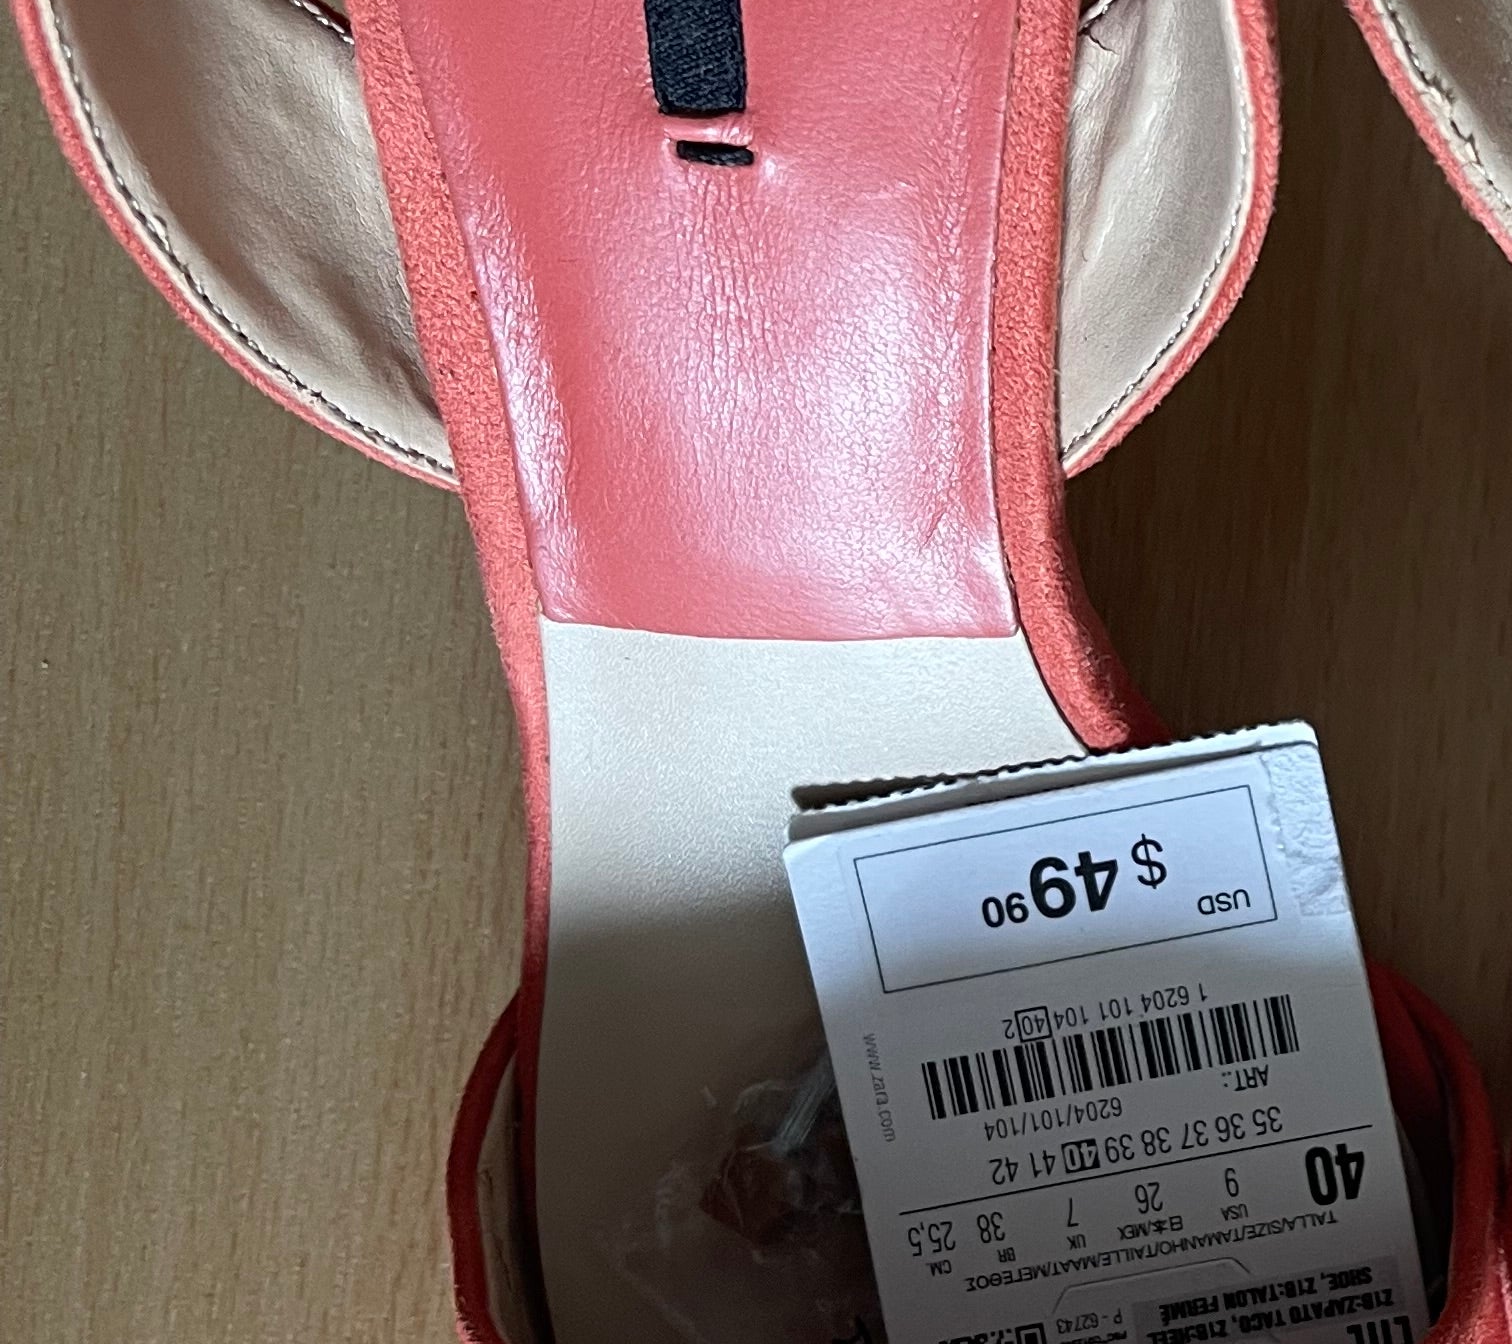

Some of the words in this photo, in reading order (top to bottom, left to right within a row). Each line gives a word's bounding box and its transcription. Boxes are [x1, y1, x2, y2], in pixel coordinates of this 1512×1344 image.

[1197, 888, 1251, 915] USD
[1140, 985, 1189, 1014] 6204
[1198, 983, 1208, 1002] 1
[1053, 1005, 1089, 1030] 104
[1098, 997, 1133, 1021] 101
[1001, 1018, 1015, 1039] 2
[1021, 1015, 1046, 1036] 40
[863, 1033, 896, 1143] www.zara.com
[1221, 1064, 1268, 1092] ART.:
[984, 1096, 1122, 1141] 6204/101/104
[1214, 1112, 1246, 1143] 36
[1252, 1106, 1283, 1136] 35
[1104, 1133, 1135, 1164] 39
[1140, 1126, 1172, 1157] 38
[1180, 1119, 1209, 1150] 37
[988, 1156, 1018, 1185] 42
[1029, 1149, 1056, 1178] 41
[1062, 1141, 1098, 1171] 40
[1224, 1167, 1239, 1197] 9
[1304, 1143, 1365, 1206] 40
[1134, 1181, 1163, 1214] 26
[1220, 1203, 1249, 1221] USA
[1066, 1197, 1079, 1228] 7
[907, 1220, 956, 1257] 25,5
[976, 1211, 1006, 1244] 38
[1066, 1233, 1086, 1250] UK
[996, 1246, 1016, 1263] BR
[1320, 1266, 1373, 1291] SHOE,
[1158, 1295, 1219, 1327] FERMÉ
[1231, 1309, 1287, 1334] TACO,
